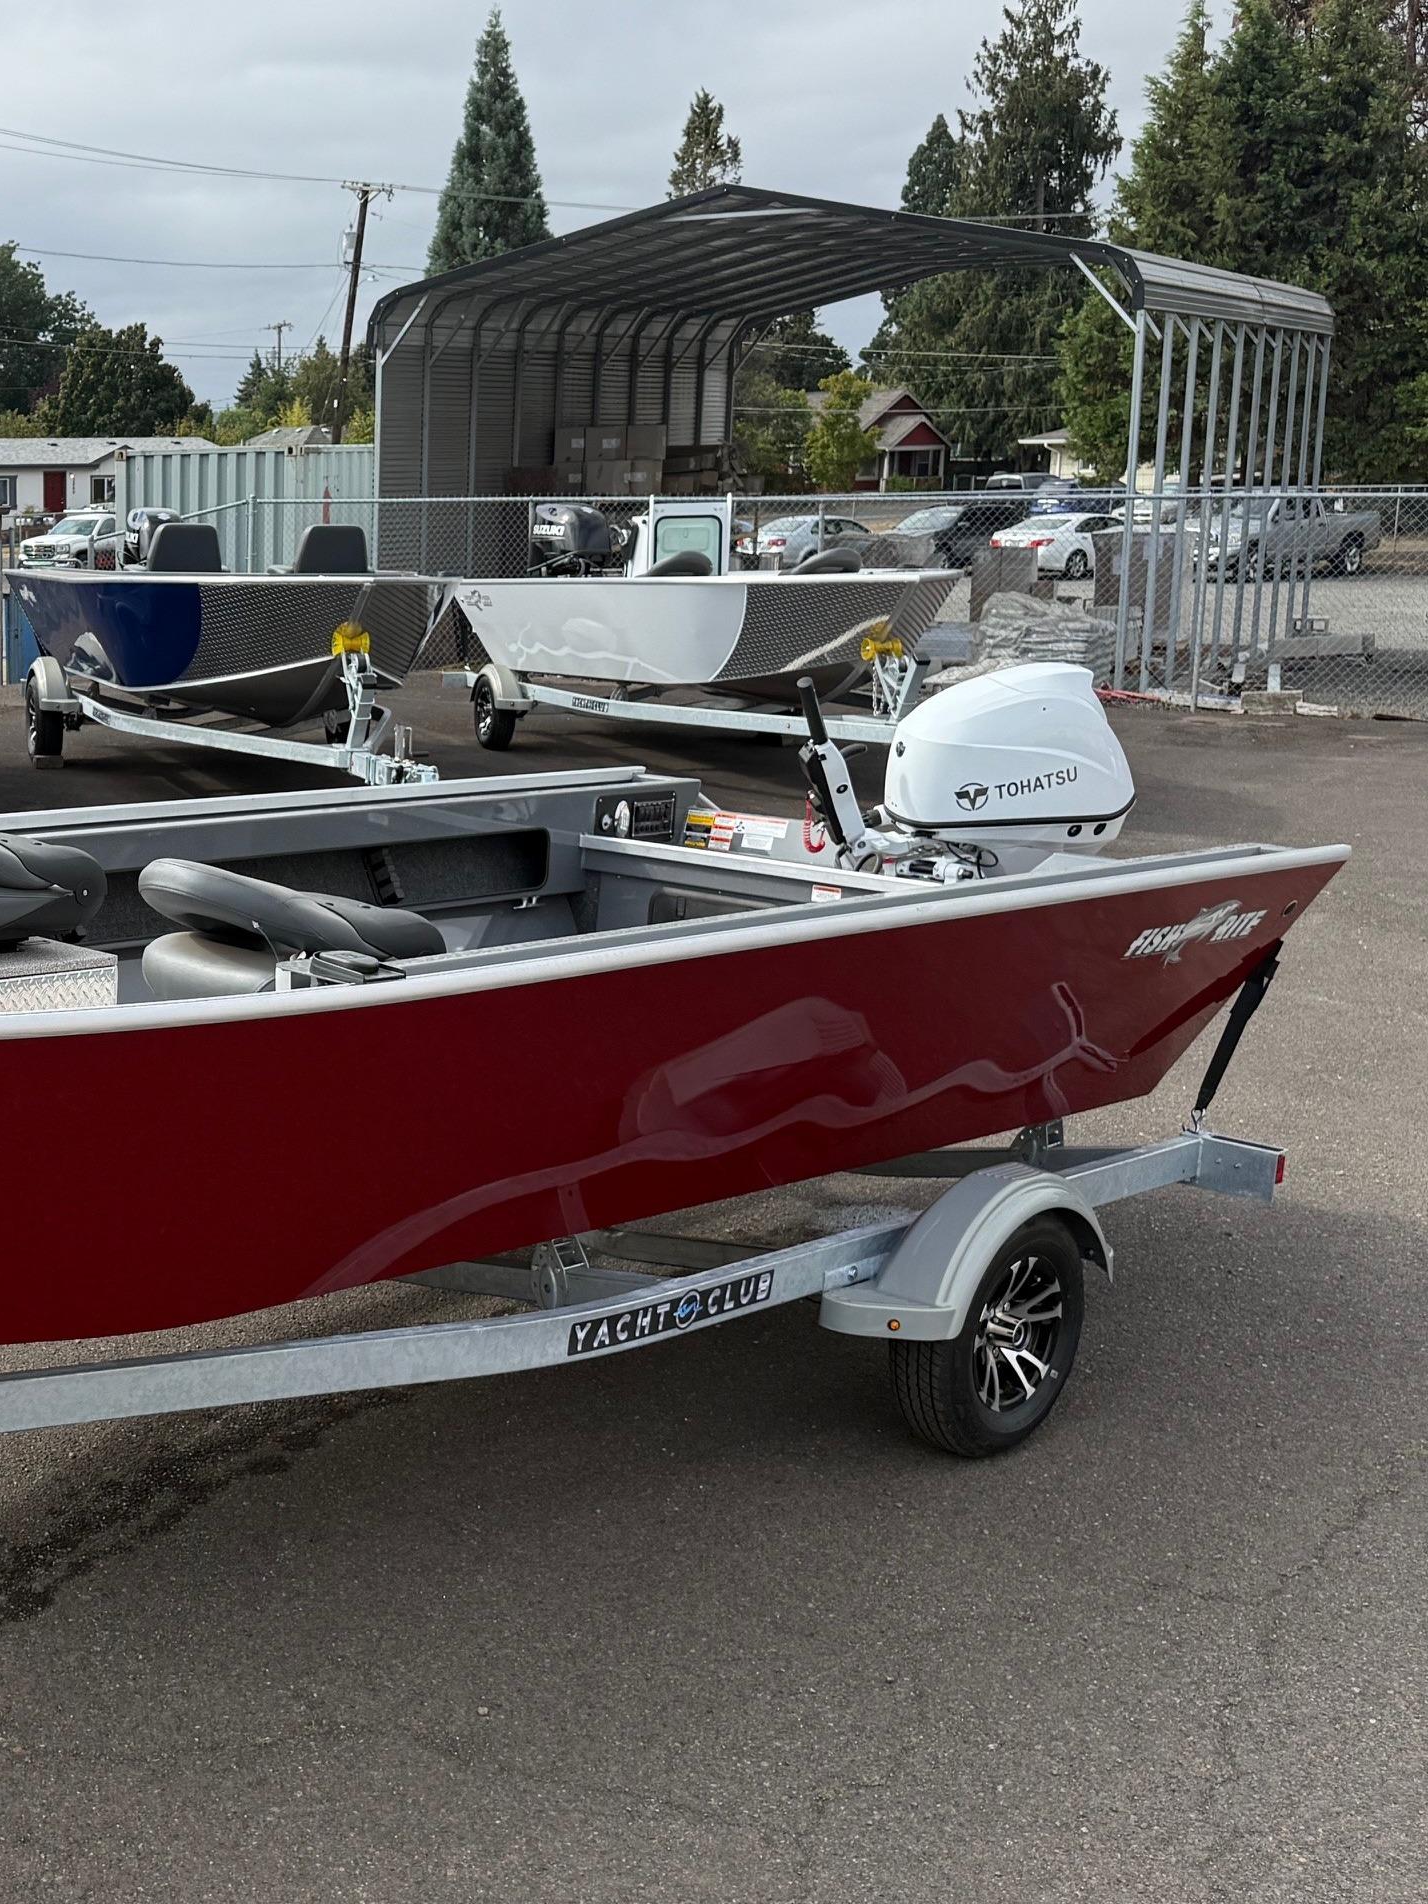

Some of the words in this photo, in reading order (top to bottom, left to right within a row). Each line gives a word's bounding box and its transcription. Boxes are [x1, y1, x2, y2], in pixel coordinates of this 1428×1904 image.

[533, 524, 566, 537] SUZUKI
[994, 766, 1078, 800] TOHATSU
[1209, 909, 1269, 942] RITE
[574, 1302, 672, 1352] YACHT
[707, 1271, 772, 1316] CLUB
